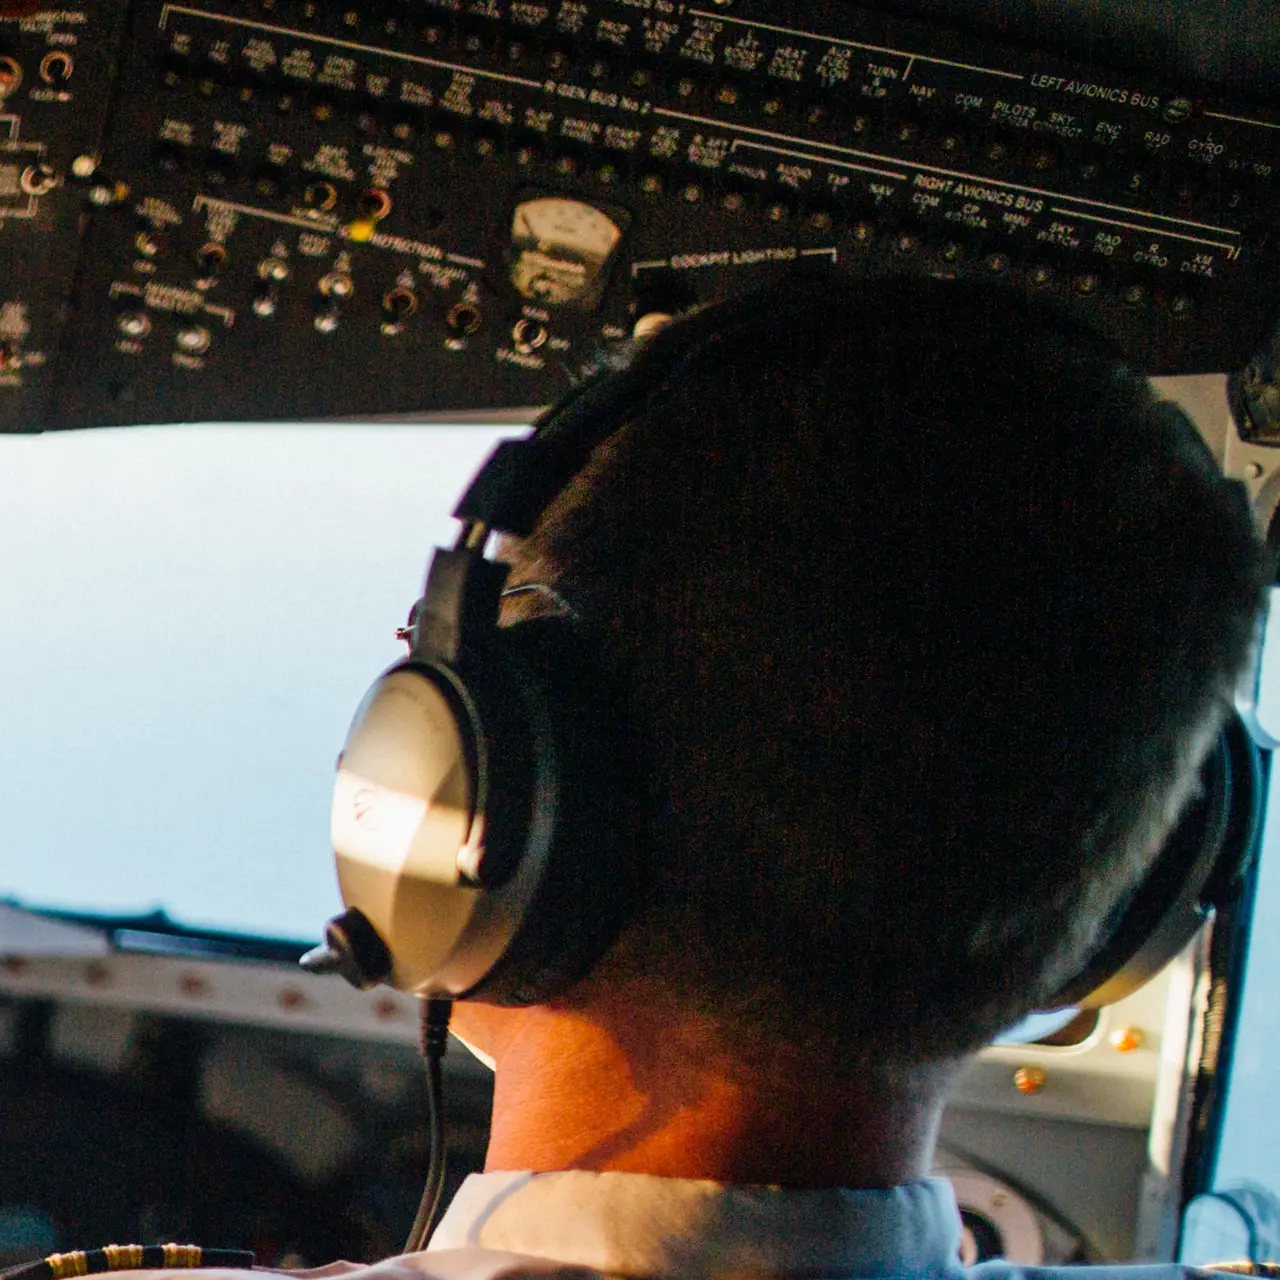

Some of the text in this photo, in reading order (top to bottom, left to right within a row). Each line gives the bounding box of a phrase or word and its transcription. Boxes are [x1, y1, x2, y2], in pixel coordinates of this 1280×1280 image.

[866, 62, 899, 80] TURN
[908, 83, 937, 99] NAV
[1030, 72, 1161, 110] LEFT AVIONICS BUS
[953, 92, 984, 109] COM
[992, 99, 1038, 120] PILOTS
[1048, 111, 1076, 126] SKY
[1143, 130, 1171, 147] RAD
[1187, 138, 1224, 157] GYRO
[1129, 173, 1143, 190] 5
[911, 191, 941, 208] COM
[912, 172, 1044, 213] RIGHT AVIONICS BUS
[1227, 189, 1241, 209] 3
[1049, 221, 1076, 236] SKY
[1036, 231, 1081, 249] WATCH
[1094, 232, 1122, 247] RAD
[1092, 243, 1115, 257] IND
[1148, 243, 1160, 254] R
[669, 246, 798, 270] COCKPIT LIGHTING
[1132, 250, 1169, 269] GYRO
[1193, 253, 1214, 266] XM
[1179, 261, 1214, 279] DATA
